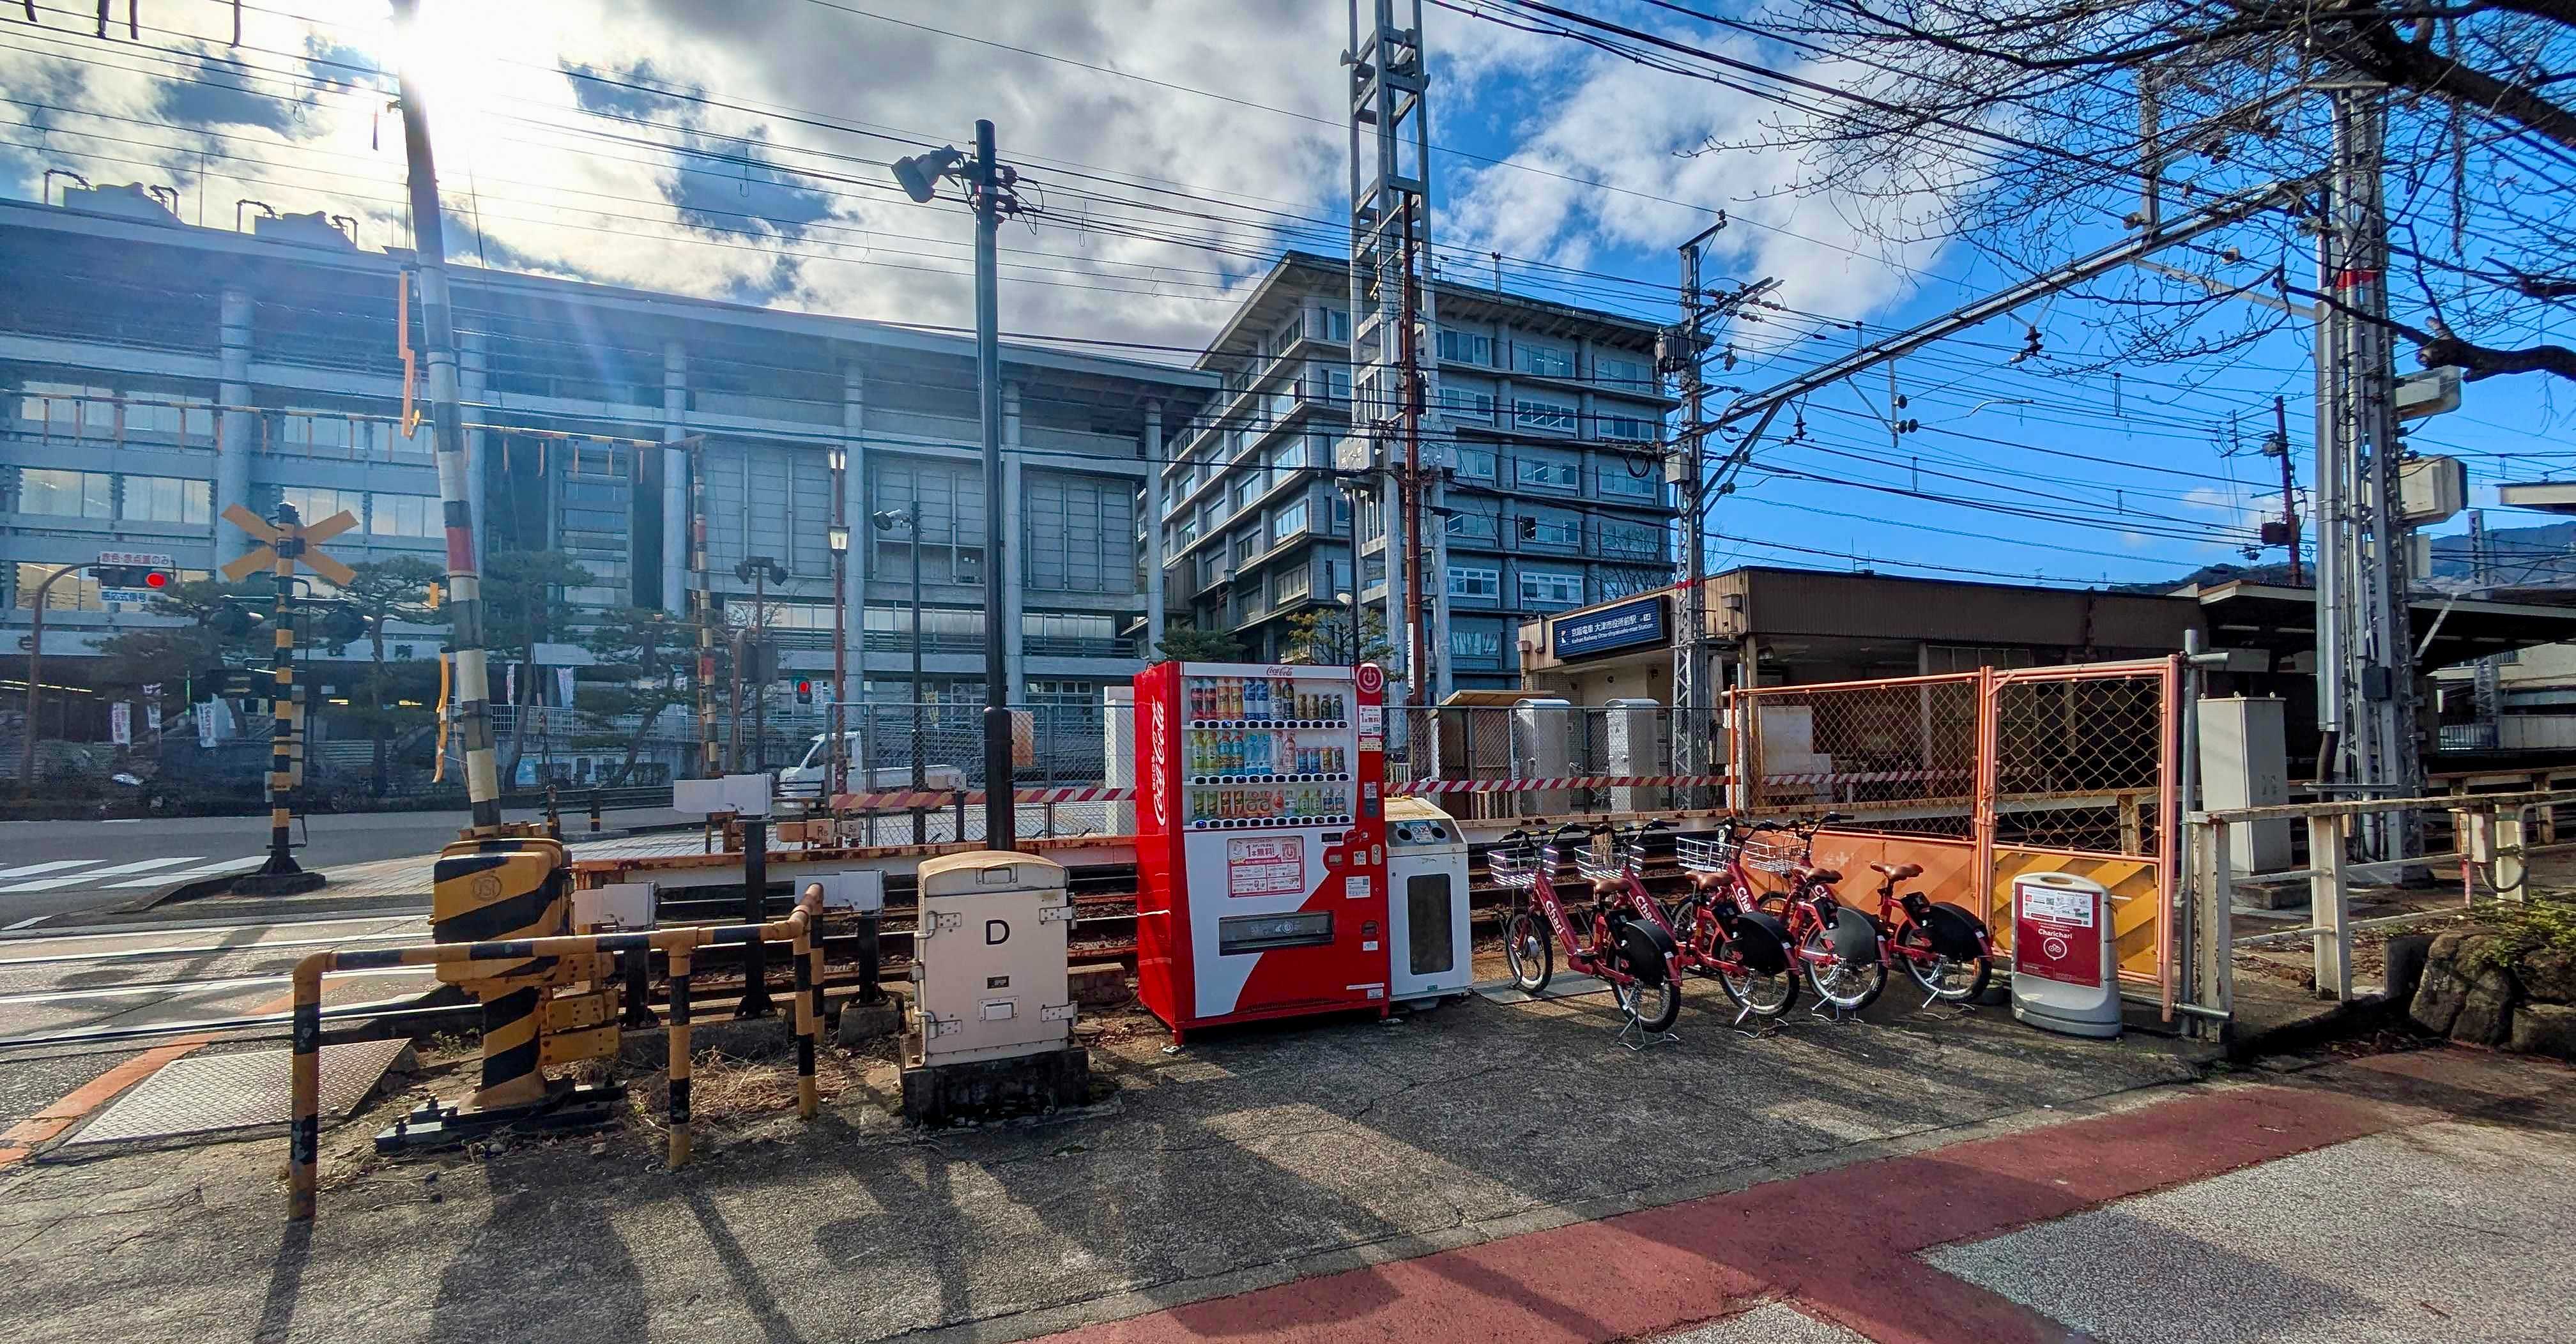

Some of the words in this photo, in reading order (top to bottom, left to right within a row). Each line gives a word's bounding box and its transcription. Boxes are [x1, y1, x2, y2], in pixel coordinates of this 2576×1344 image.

[1545, 900, 1565, 935] Chari
[985, 919, 1011, 945] D
[2037, 929, 2073, 940] Charichari
